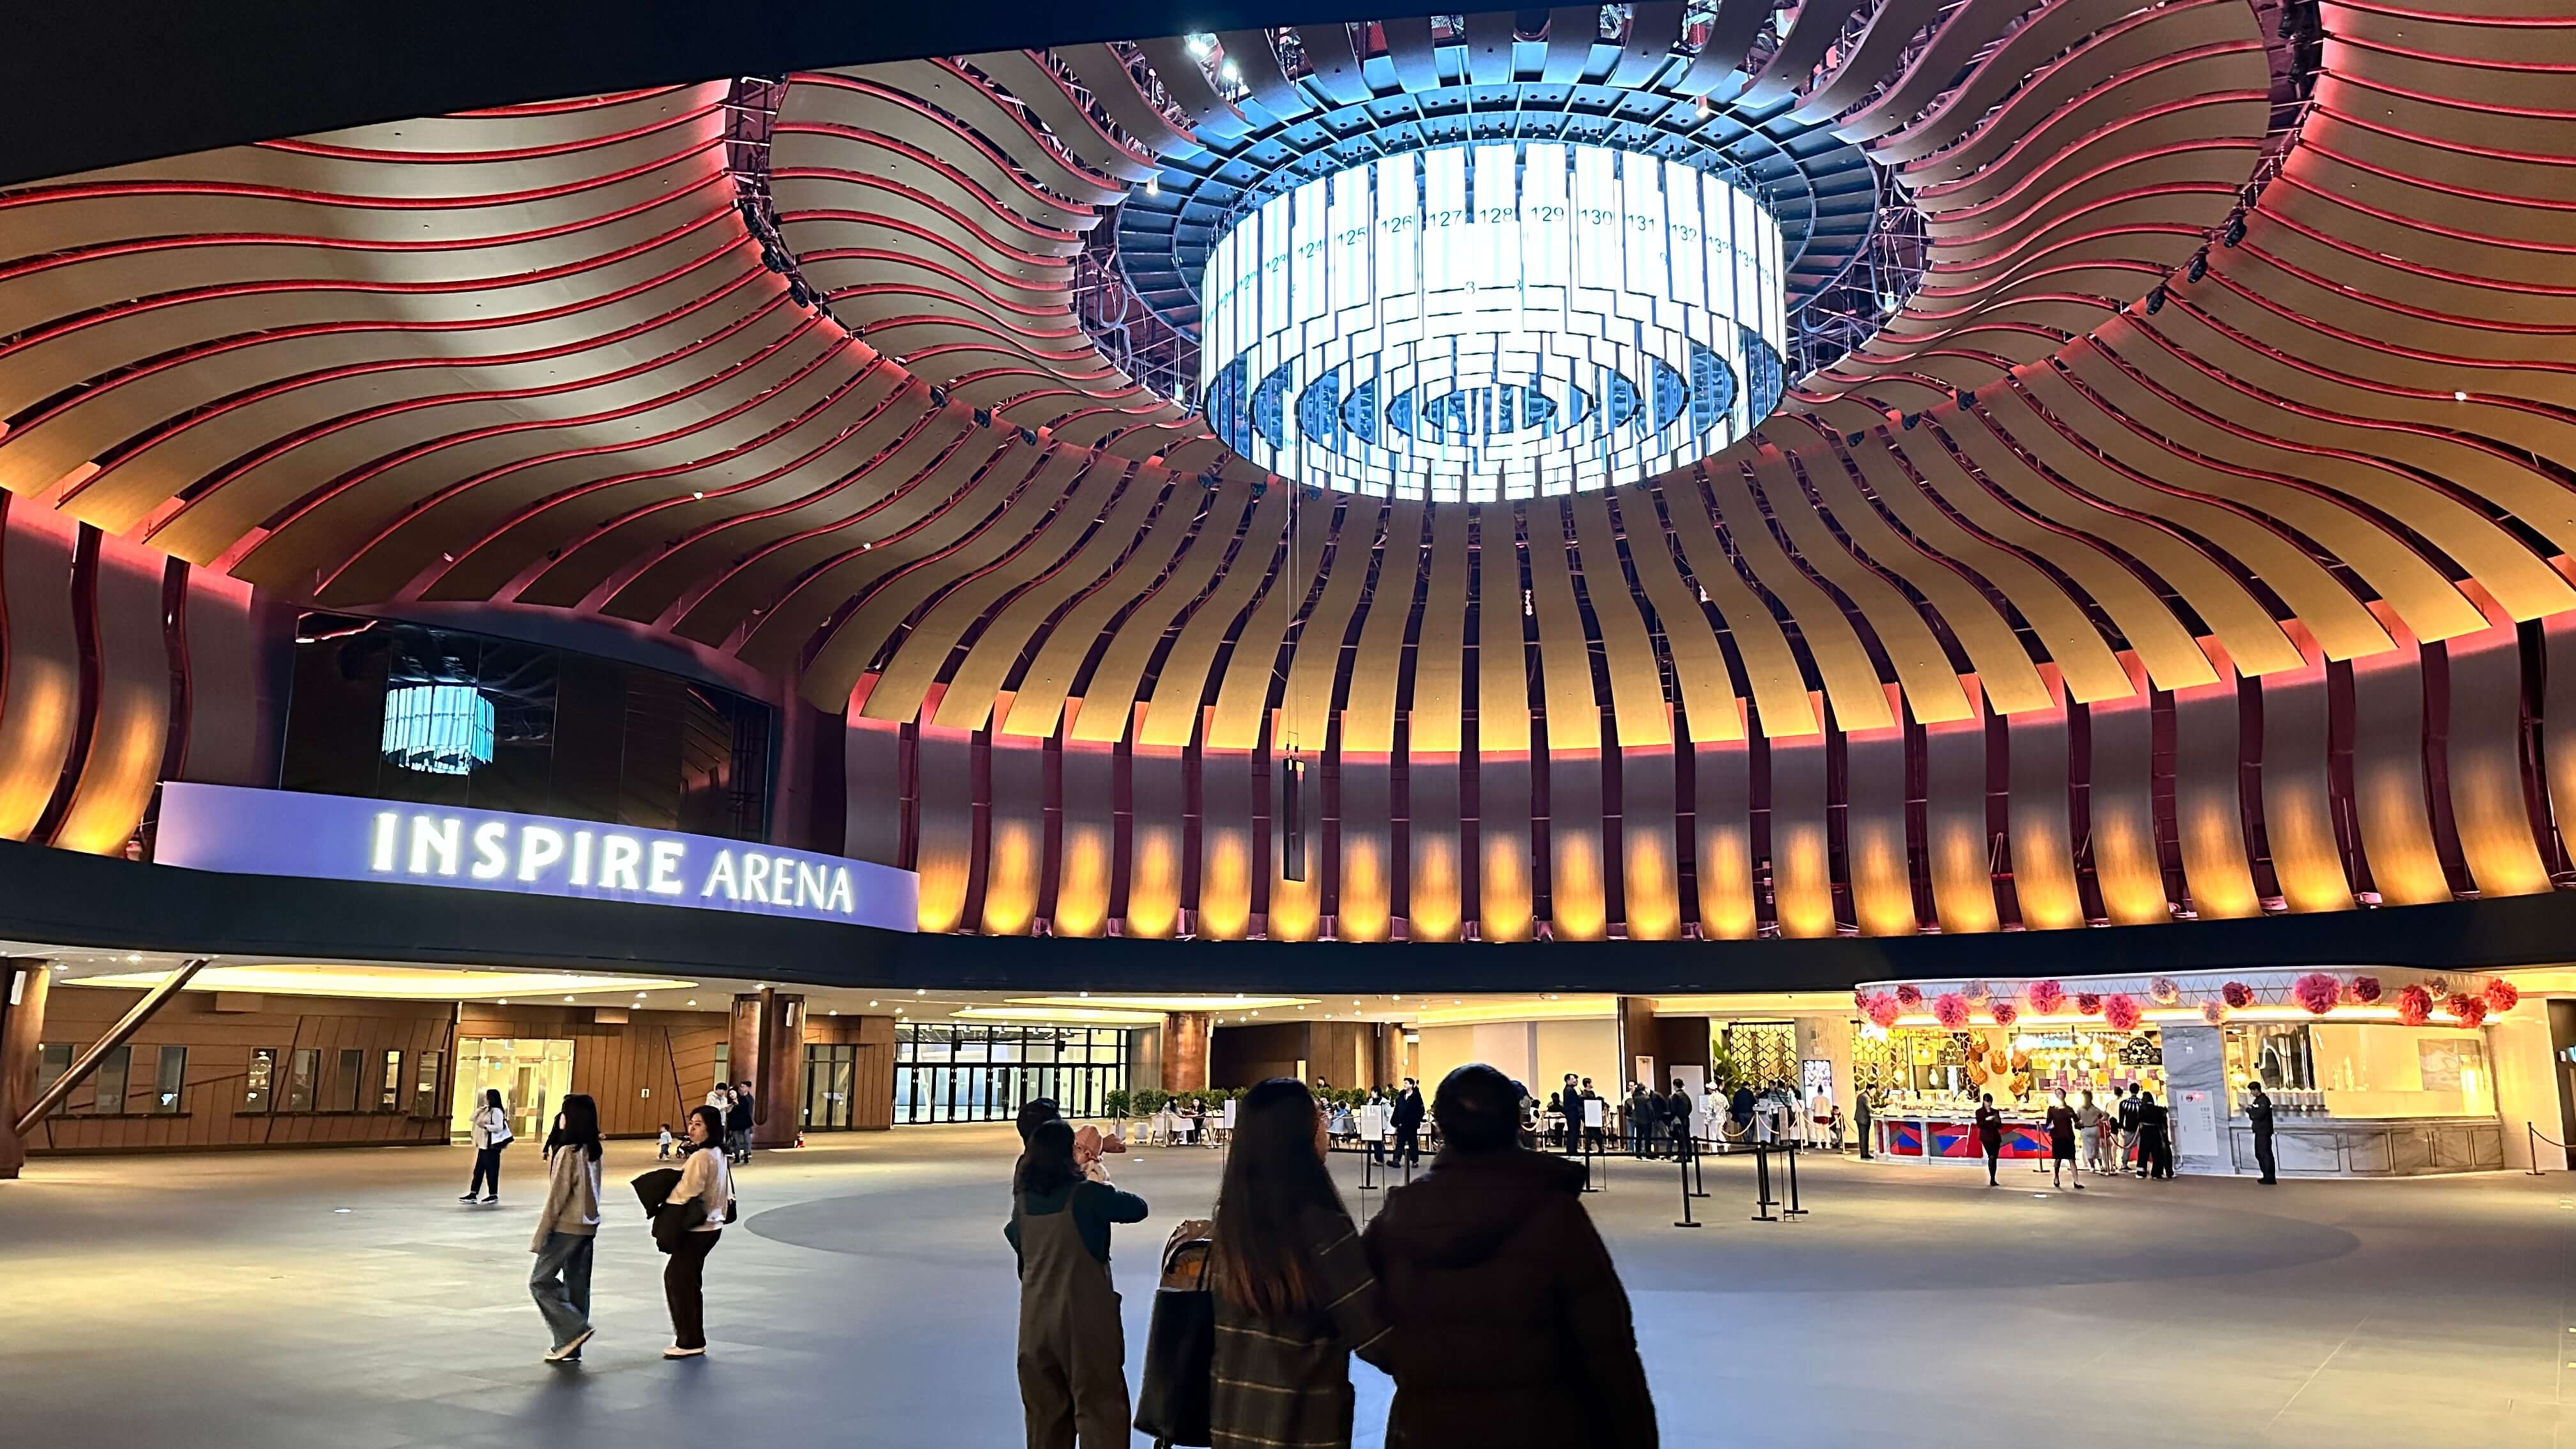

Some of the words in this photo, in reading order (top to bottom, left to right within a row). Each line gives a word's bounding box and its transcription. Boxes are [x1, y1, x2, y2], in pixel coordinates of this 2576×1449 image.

[1429, 210, 1462, 227] 127
[1480, 208, 1514, 224] 128
[1531, 206, 1564, 222] 129
[1581, 209, 1613, 226] 130
[1381, 215, 1413, 234] 126
[1628, 215, 1655, 233] 131
[1337, 227, 1366, 248] 125
[1672, 224, 1698, 243] 132
[373, 812, 686, 894] INSPIRE
[702, 849, 855, 914] ARENA
